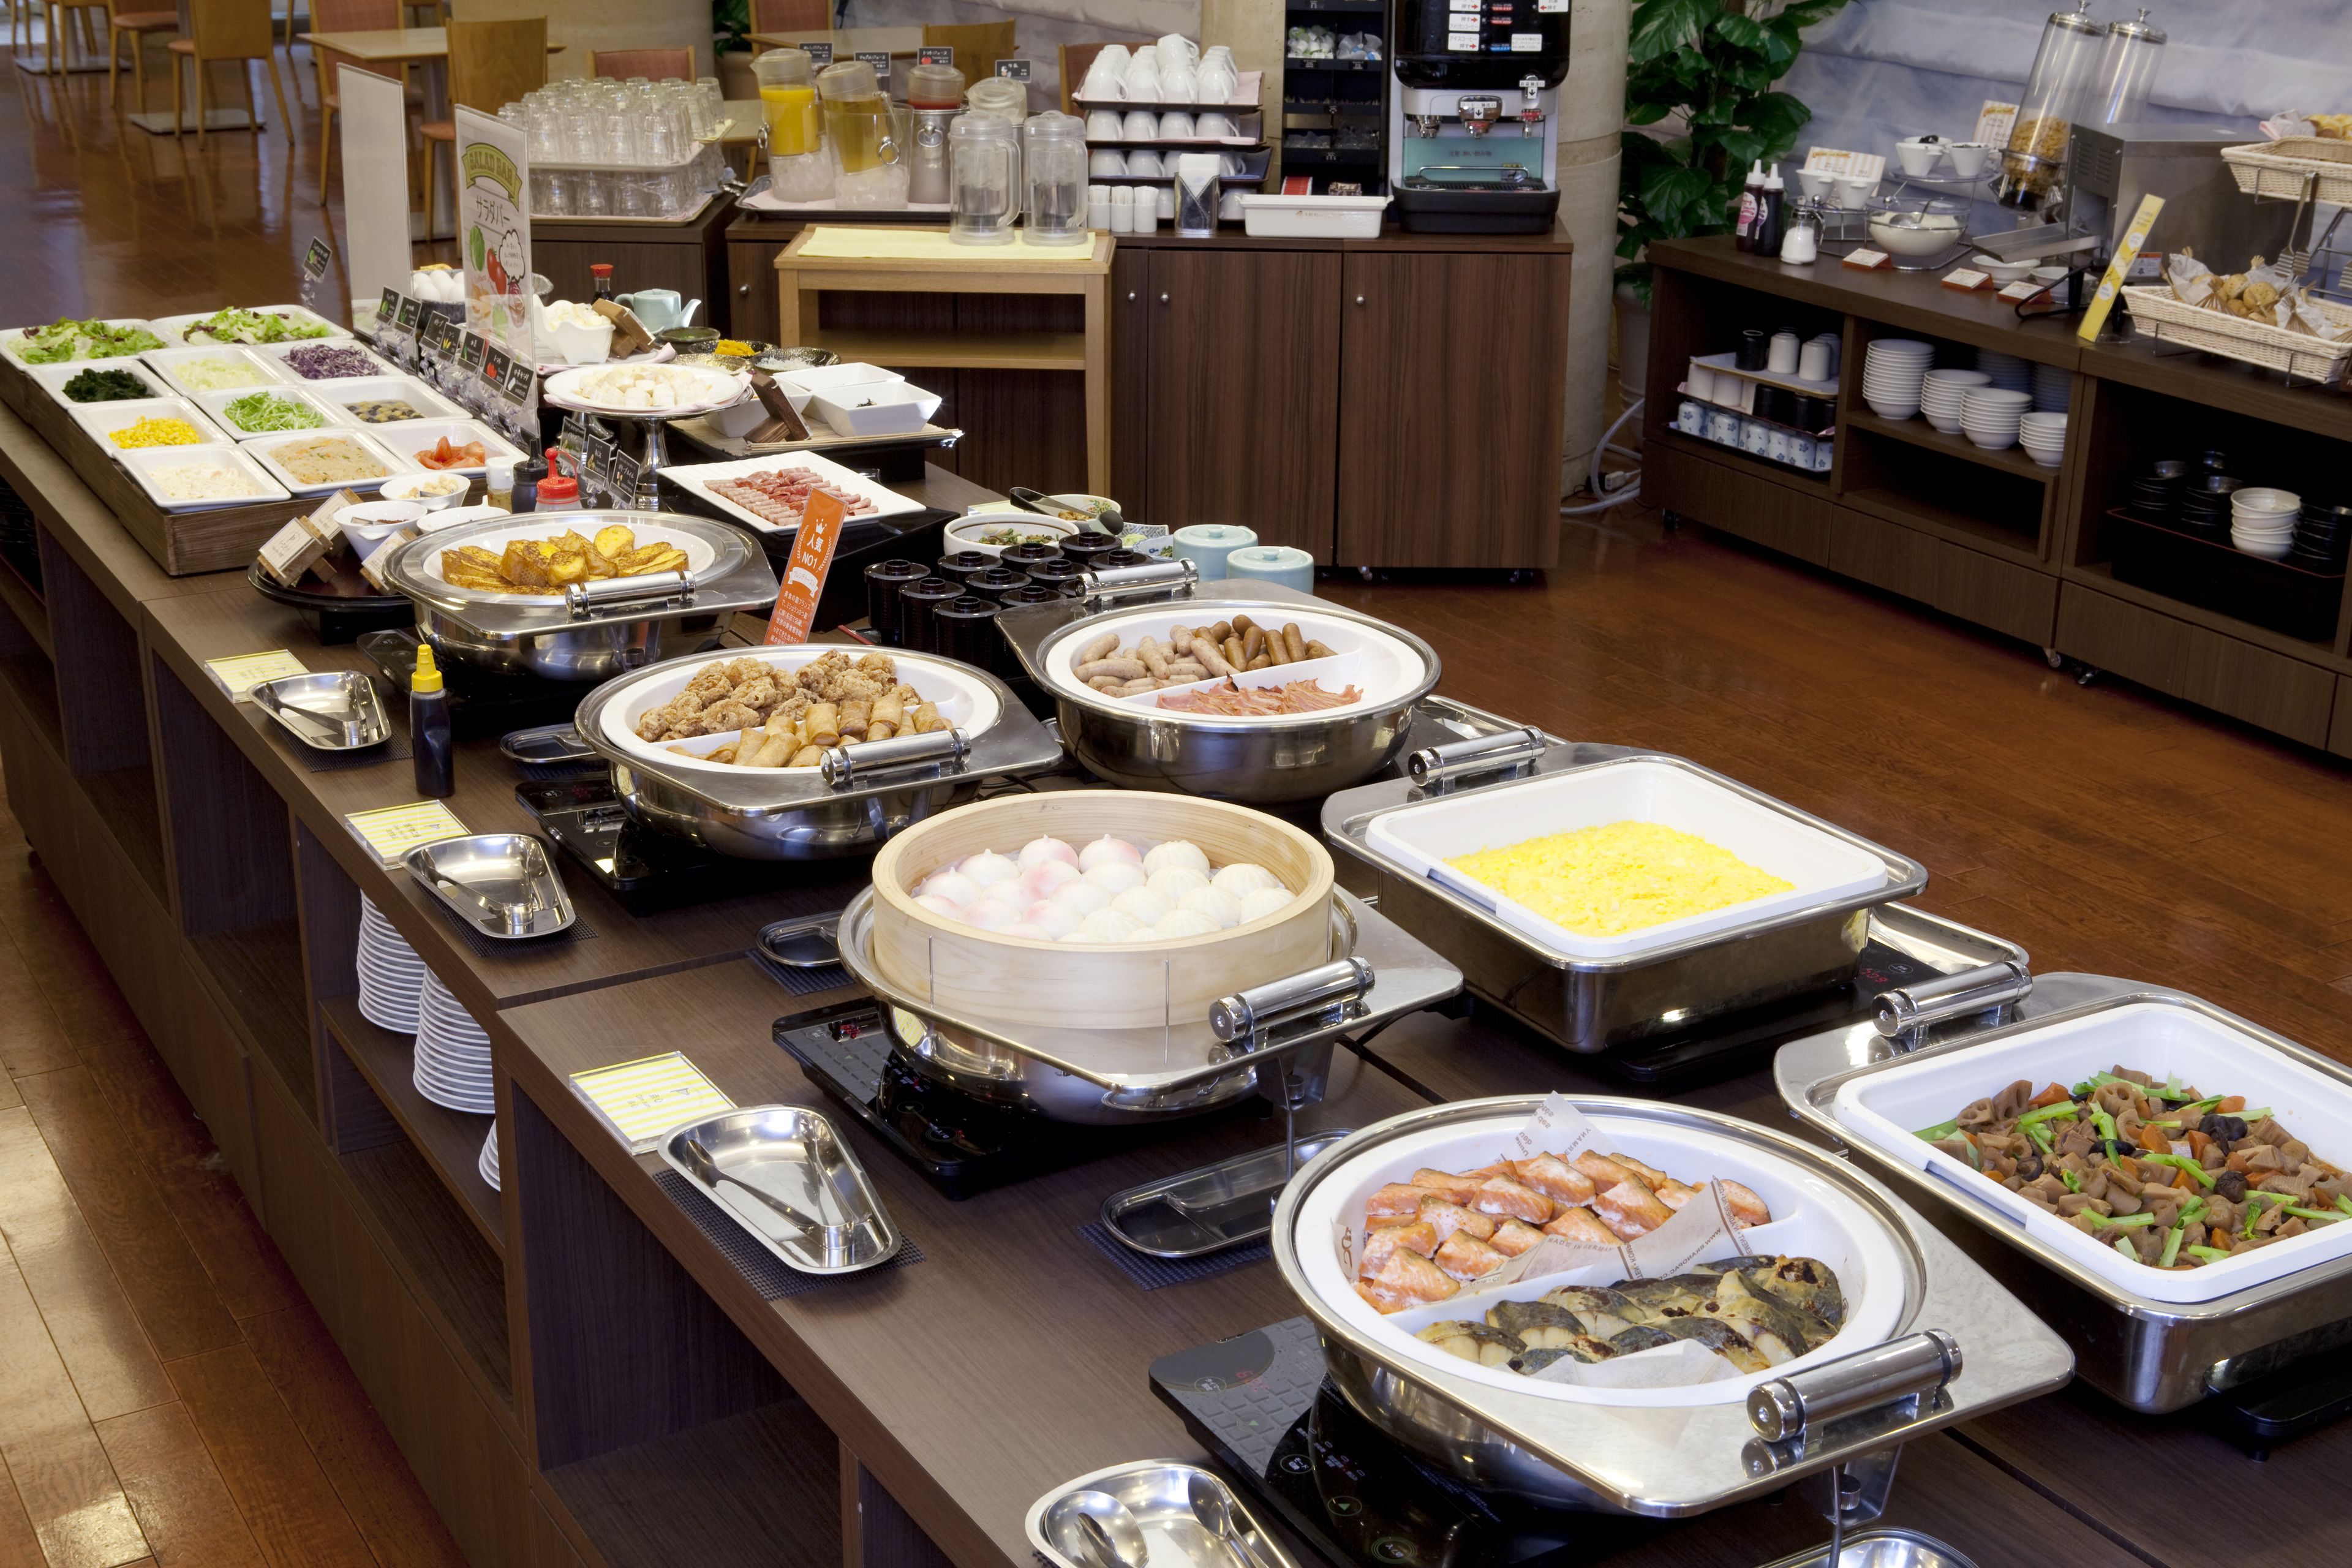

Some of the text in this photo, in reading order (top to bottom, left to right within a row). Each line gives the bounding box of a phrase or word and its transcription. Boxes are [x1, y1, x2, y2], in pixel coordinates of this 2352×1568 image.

[469, 152, 513, 186] SALAD BAR
[476, 195, 510, 227] サラダバー
[807, 533, 824, 553] 人気
[802, 551, 818, 569] NO1
[1547, 1237, 1572, 1249] MADE
[1583, 1244, 1613, 1253] GERMAN
